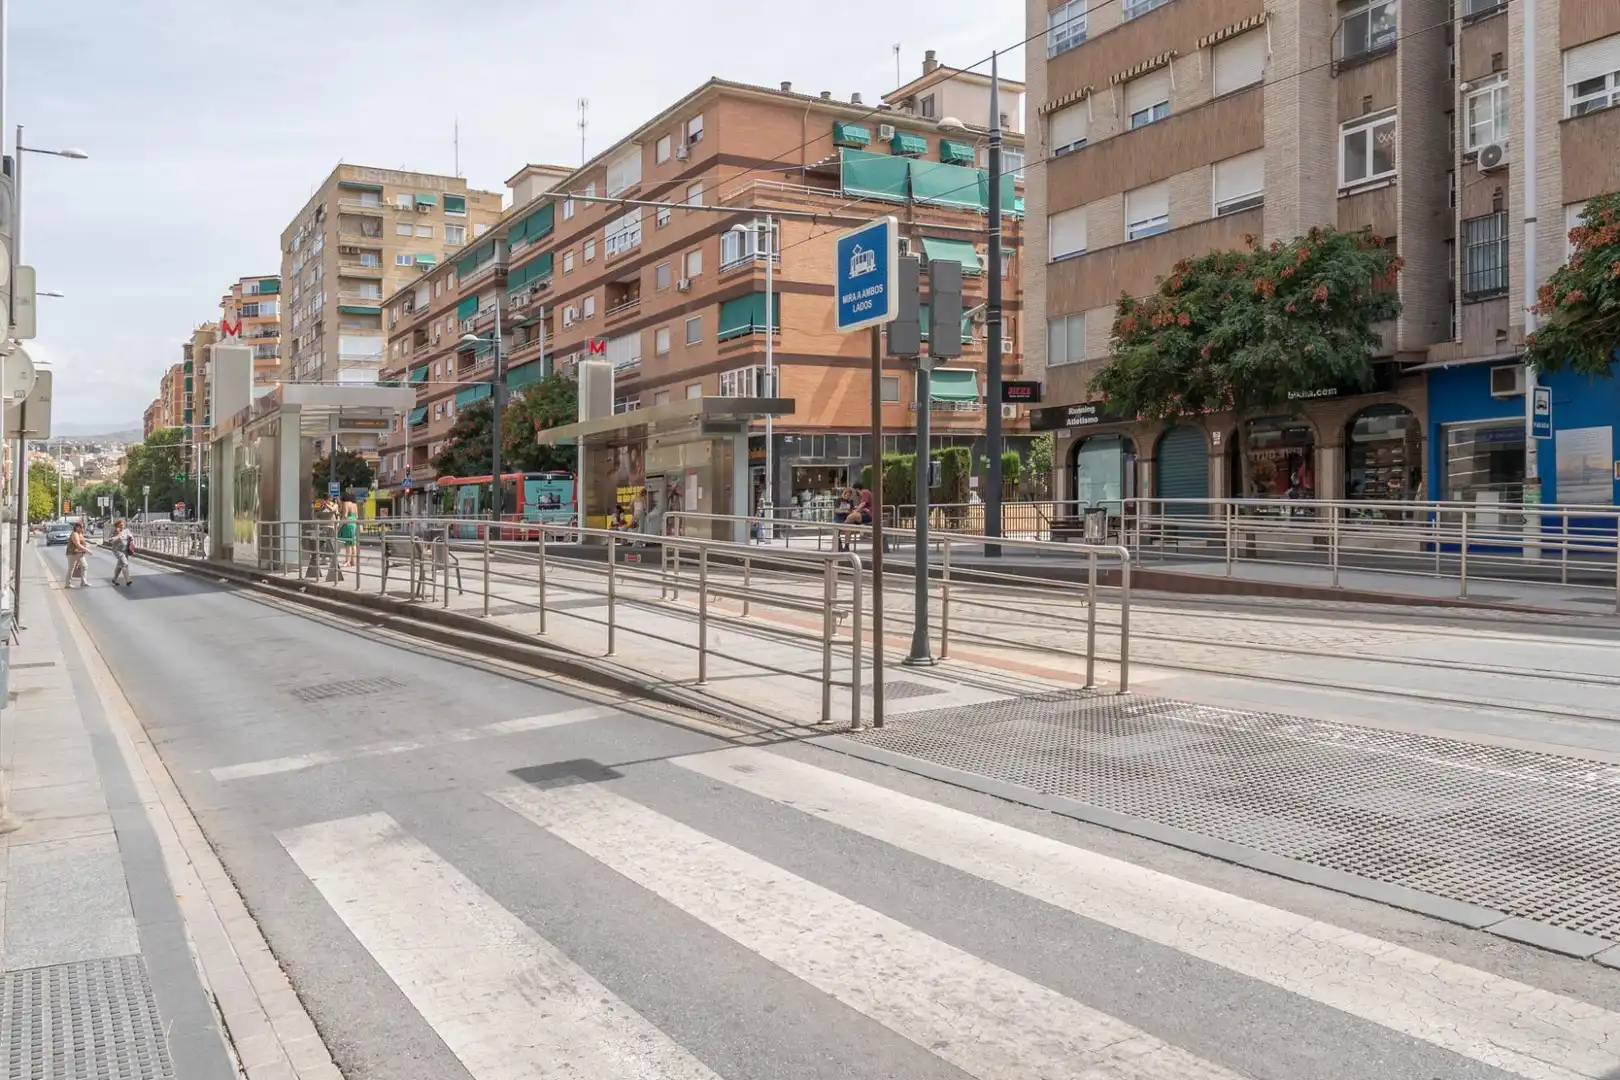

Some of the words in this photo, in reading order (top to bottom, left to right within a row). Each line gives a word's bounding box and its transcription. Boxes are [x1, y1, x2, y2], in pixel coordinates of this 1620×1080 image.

[842, 293, 857, 304] MIRA
[862, 284, 884, 298] AMBOS
[852, 299, 873, 313] LADOS
[222, 319, 242, 336] M
[589, 338, 606, 354] M
[1068, 406, 1096, 415] Running
[1066, 417, 1099, 426] Atletismo
